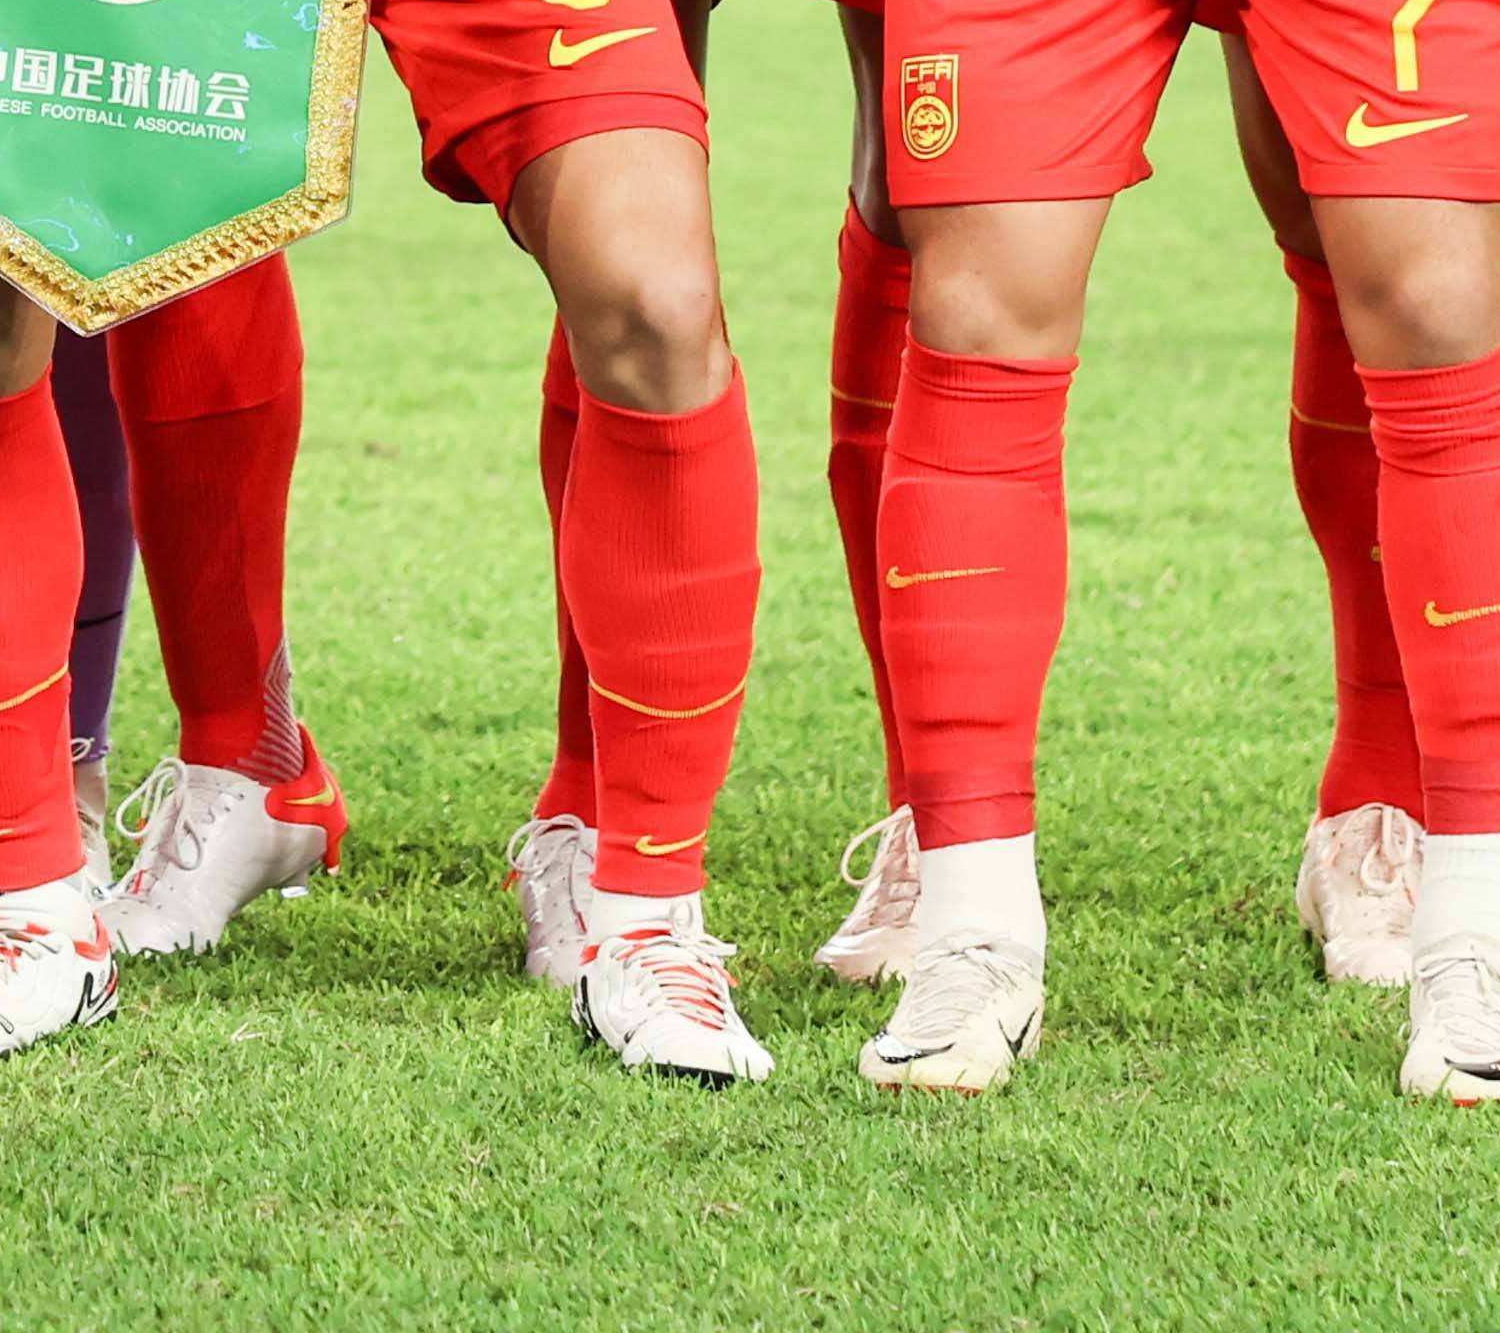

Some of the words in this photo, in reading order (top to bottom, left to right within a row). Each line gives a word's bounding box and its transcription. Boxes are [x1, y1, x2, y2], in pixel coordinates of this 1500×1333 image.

[904, 62, 952, 83] CFA
[41, 102, 127, 128] FOOTBALL
[134, 115, 247, 142] ASSOCIATION
